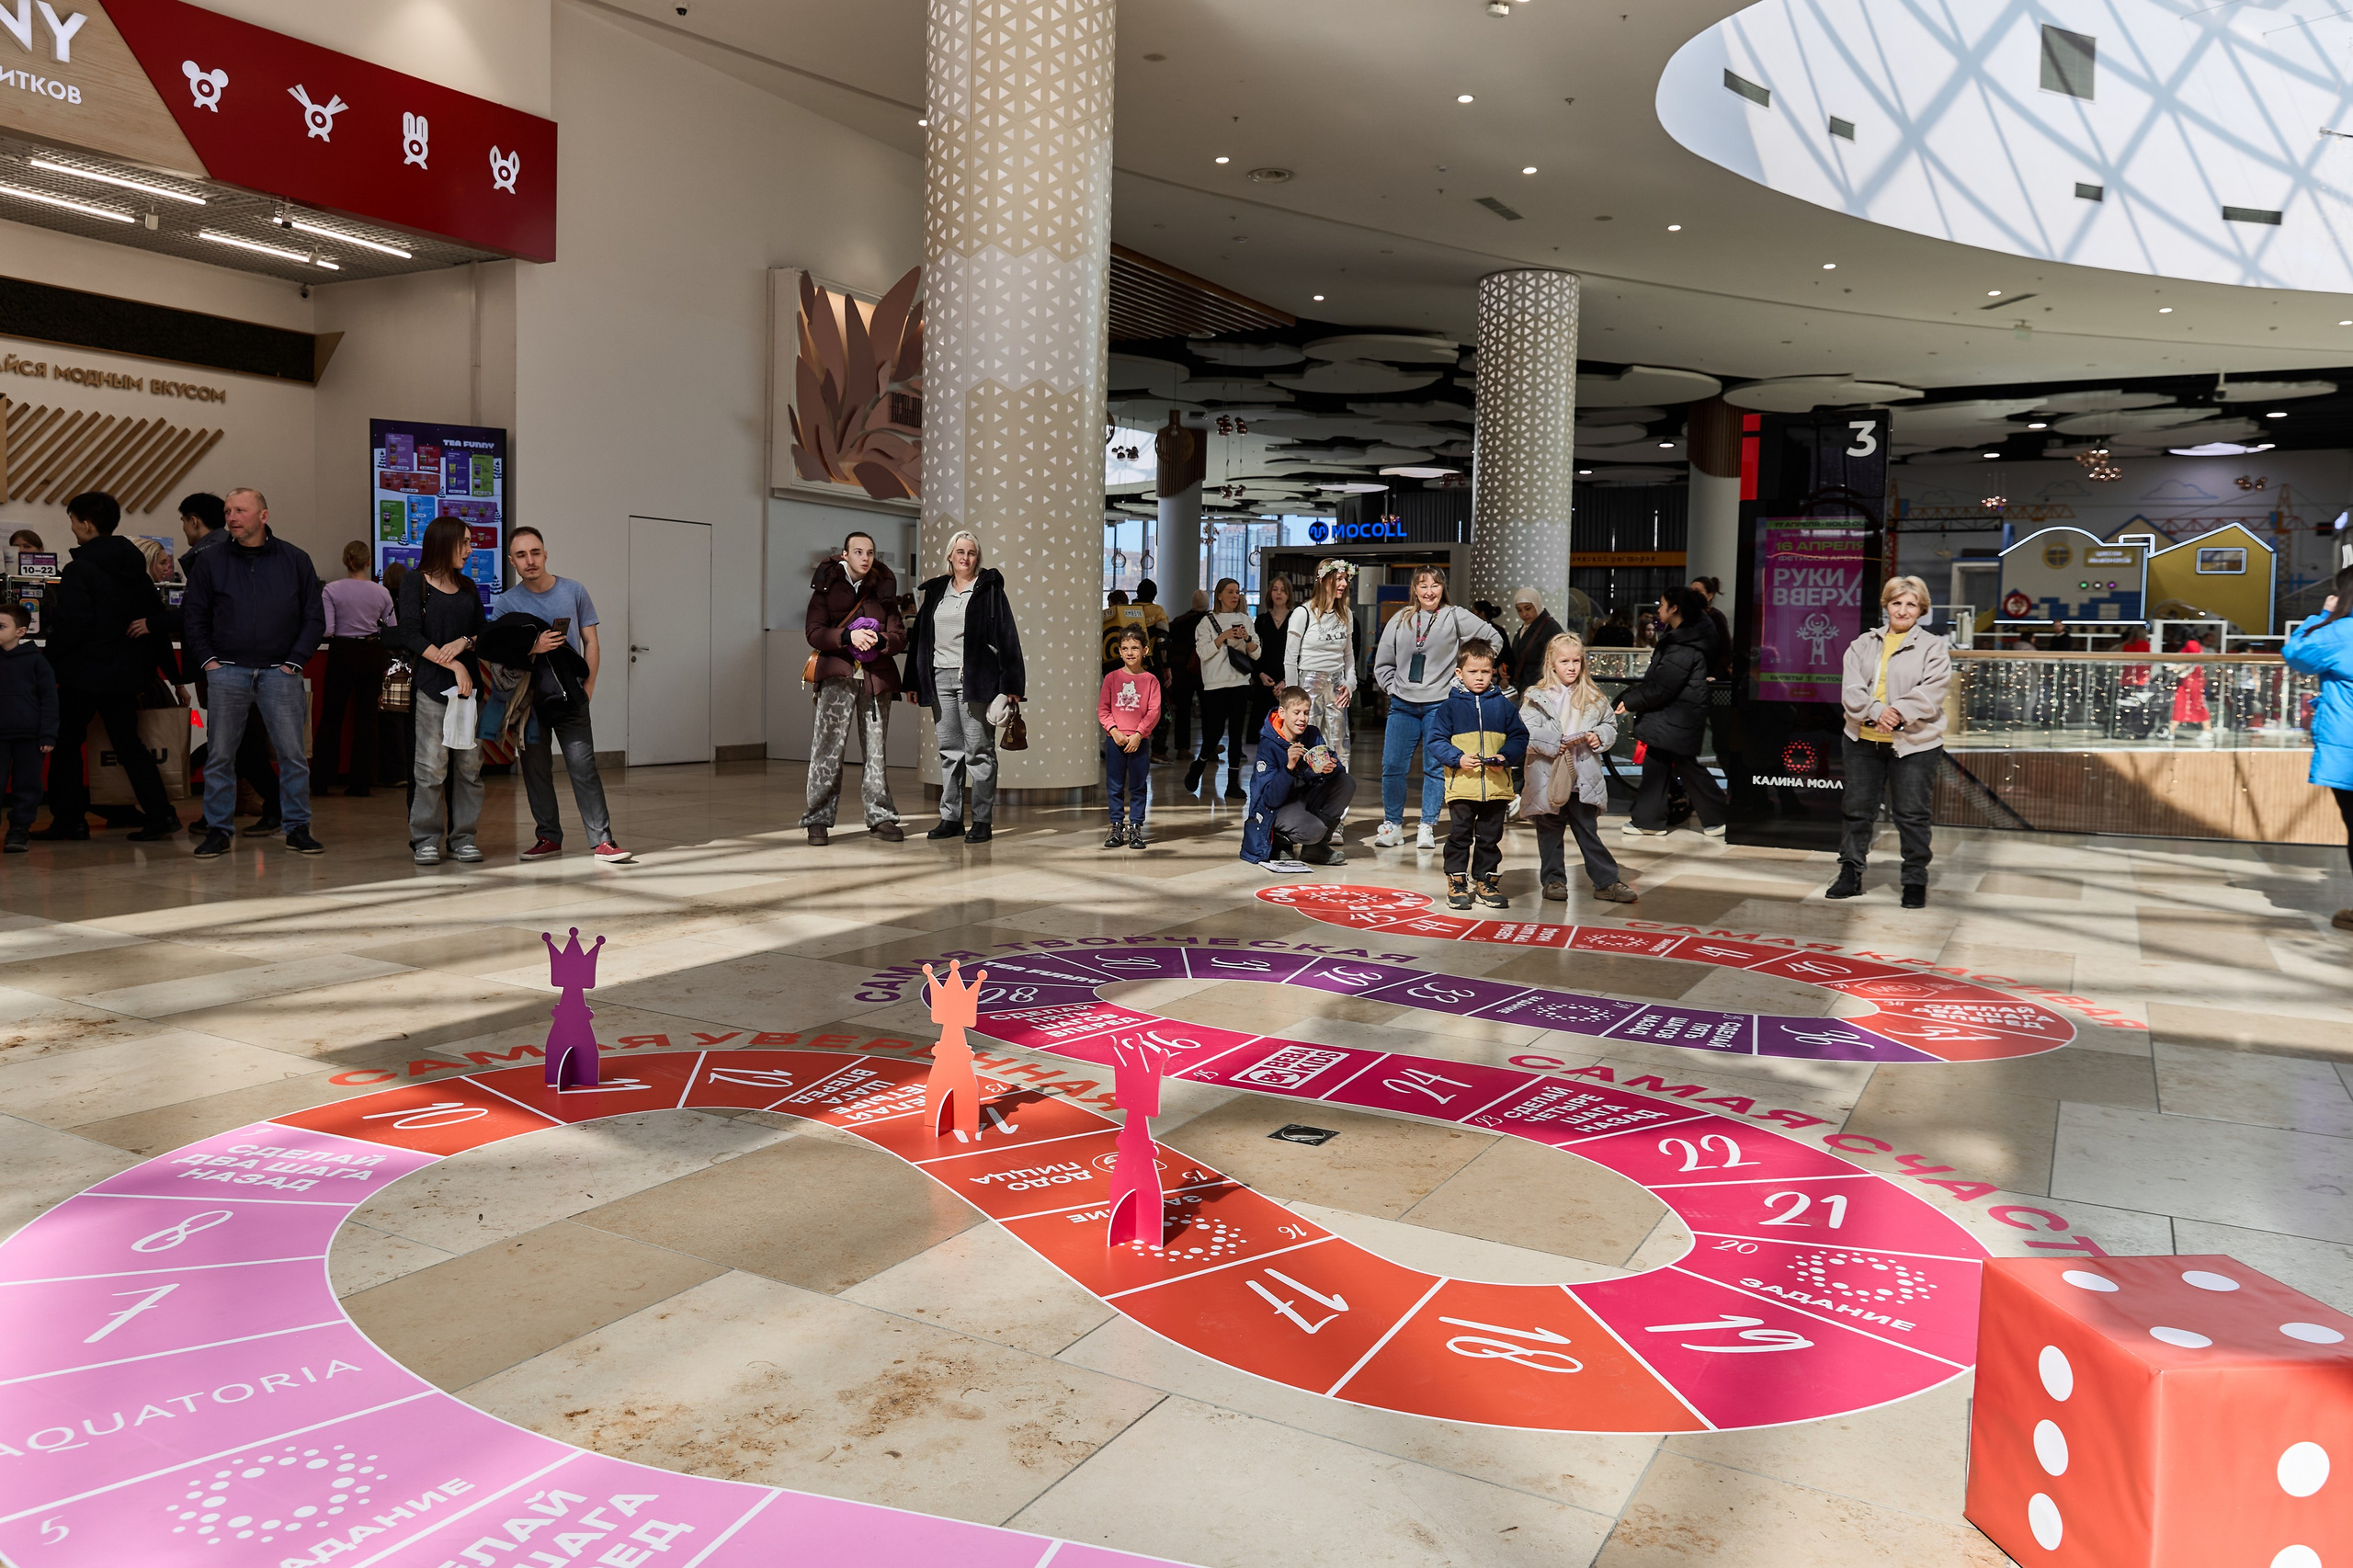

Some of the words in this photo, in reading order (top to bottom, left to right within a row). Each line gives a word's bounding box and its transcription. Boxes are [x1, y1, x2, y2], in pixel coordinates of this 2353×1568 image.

[0, 65, 82, 105] ИТКОВ
[0, 353, 47, 378] ЙСЯ
[54, 364, 143, 392] МОДНЫМ
[151, 379, 226, 404] ВКУСОМ
[443, 438, 461, 447] TEA
[463, 440, 494, 449] FUNNY
[1846, 420, 1877, 457] 3
[1332, 523, 1407, 539] MOCOLL
[1776, 541, 1793, 551] 16
[1796, 540, 1864, 551] АПРЕЛЯ
[1773, 568, 1844, 586] РУКИ
[1753, 775, 1803, 788] КАЛИНА
[1807, 778, 1844, 790] МОЛЛ
[1266, 884, 1342, 903] САМАЯ
[1347, 892, 1424, 911] САМАЯ
[1095, 954, 1162, 970] 30
[1693, 946, 1754, 960] 41
[854, 950, 987, 1003] САМАЯ
[992, 936, 1421, 963] ТВОРЧЕСКАЯ
[983, 961, 1026, 971] TEA
[1025, 969, 1107, 984] FUNNY
[1625, 922, 1844, 952] САМАЯ
[1851, 950, 2150, 1030] КРАСИВАЯ
[1785, 960, 1852, 977] 40
[977, 986, 1039, 1005] 28
[1406, 982, 1476, 1004] 33
[989, 1004, 1097, 1021] СДЕЛАЙ
[1025, 1012, 1093, 1024] ПЯТЬ
[1924, 1004, 2036, 1015] СДЕЛАЙ
[1975, 1011, 2056, 1023] ШАГА
[1030, 1013, 1120, 1031] ШАГОВ
[1045, 1017, 1142, 1038] ВПЕРЕД
[1624, 1014, 1663, 1035] НАЗАД
[1654, 1017, 1689, 1039] ШАГОВ
[328, 1034, 671, 1085] САМЯ
[1263, 1048, 1316, 1069] BEBA
[1290, 1051, 1342, 1073] KIDS
[789, 1068, 879, 1105] ВПЕРЕД
[820, 1079, 896, 1105] ШАГА
[984, 1083, 1008, 1093] 13
[1382, 1068, 1473, 1105] 24
[1507, 1054, 1827, 1130] САМАЯ
[844, 1095, 926, 1121] ЕЛАЙ
[1503, 1085, 1574, 1119] СДЕЛАЙ
[1523, 1093, 1605, 1123] ЧЕТЫРЕ
[362, 1103, 489, 1130] 10
[1474, 1114, 1503, 1128] 23
[1559, 1104, 1630, 1125] ШАГА
[1574, 1108, 1671, 1133] НАЗАД
[227, 1143, 387, 1166] СДЕЛАЙ
[1657, 1133, 1762, 1172] 22
[170, 1153, 260, 1170] ДВА
[262, 1161, 373, 1181] ШАГА
[969, 1161, 1082, 1186] ПИЦЦА
[1181, 1168, 1208, 1184] 15
[176, 1168, 321, 1192] НАЗАД
[1006, 1169, 1094, 1191] ДОДО
[1065, 1195, 1203, 1224] ЗАИЕ
[1757, 1191, 1848, 1230] 21
[131, 1210, 233, 1253] 8
[1277, 1222, 1308, 1240] 16
[1711, 1239, 1759, 1255] 20
[1245, 1267, 1349, 1335] 17
[1739, 1278, 1916, 1332] ЗАДАНИЕ
[83, 1283, 180, 1344] 7
[1438, 1316, 1584, 1373] 18
[1644, 1314, 1815, 1353] 19
[40, 1516, 70, 1546] 5
